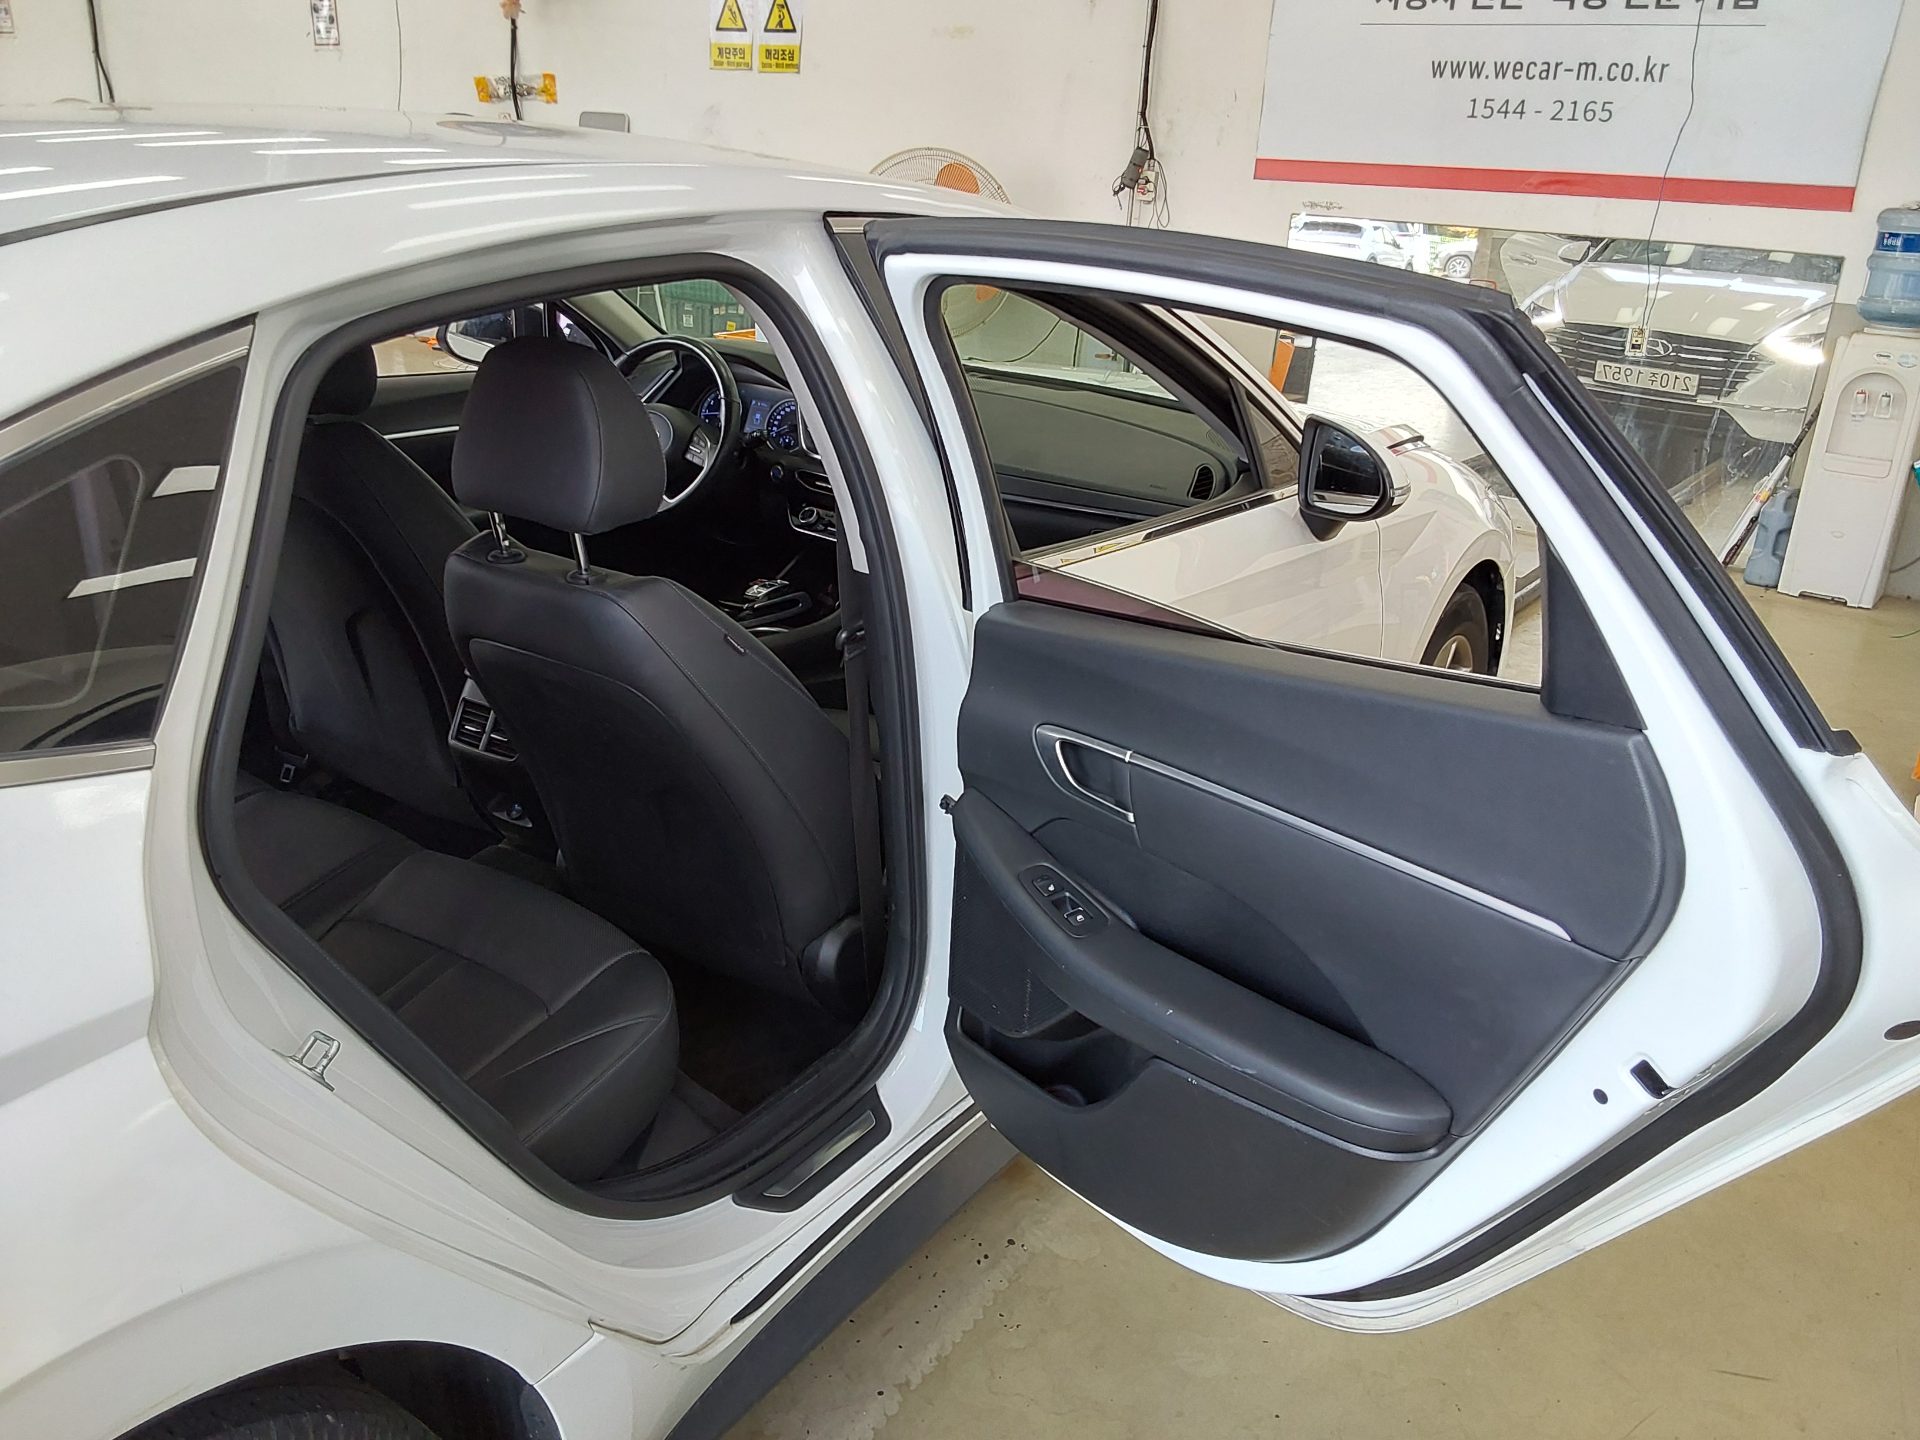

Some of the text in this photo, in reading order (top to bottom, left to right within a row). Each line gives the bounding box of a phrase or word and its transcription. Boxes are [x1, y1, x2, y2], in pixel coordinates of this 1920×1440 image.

[765, 48, 795, 61] 머리조심
[1431, 55, 1670, 83] www.wecar-m.co.kr
[1466, 98, 1527, 120] 1544
[1549, 100, 1614, 123] 2165
